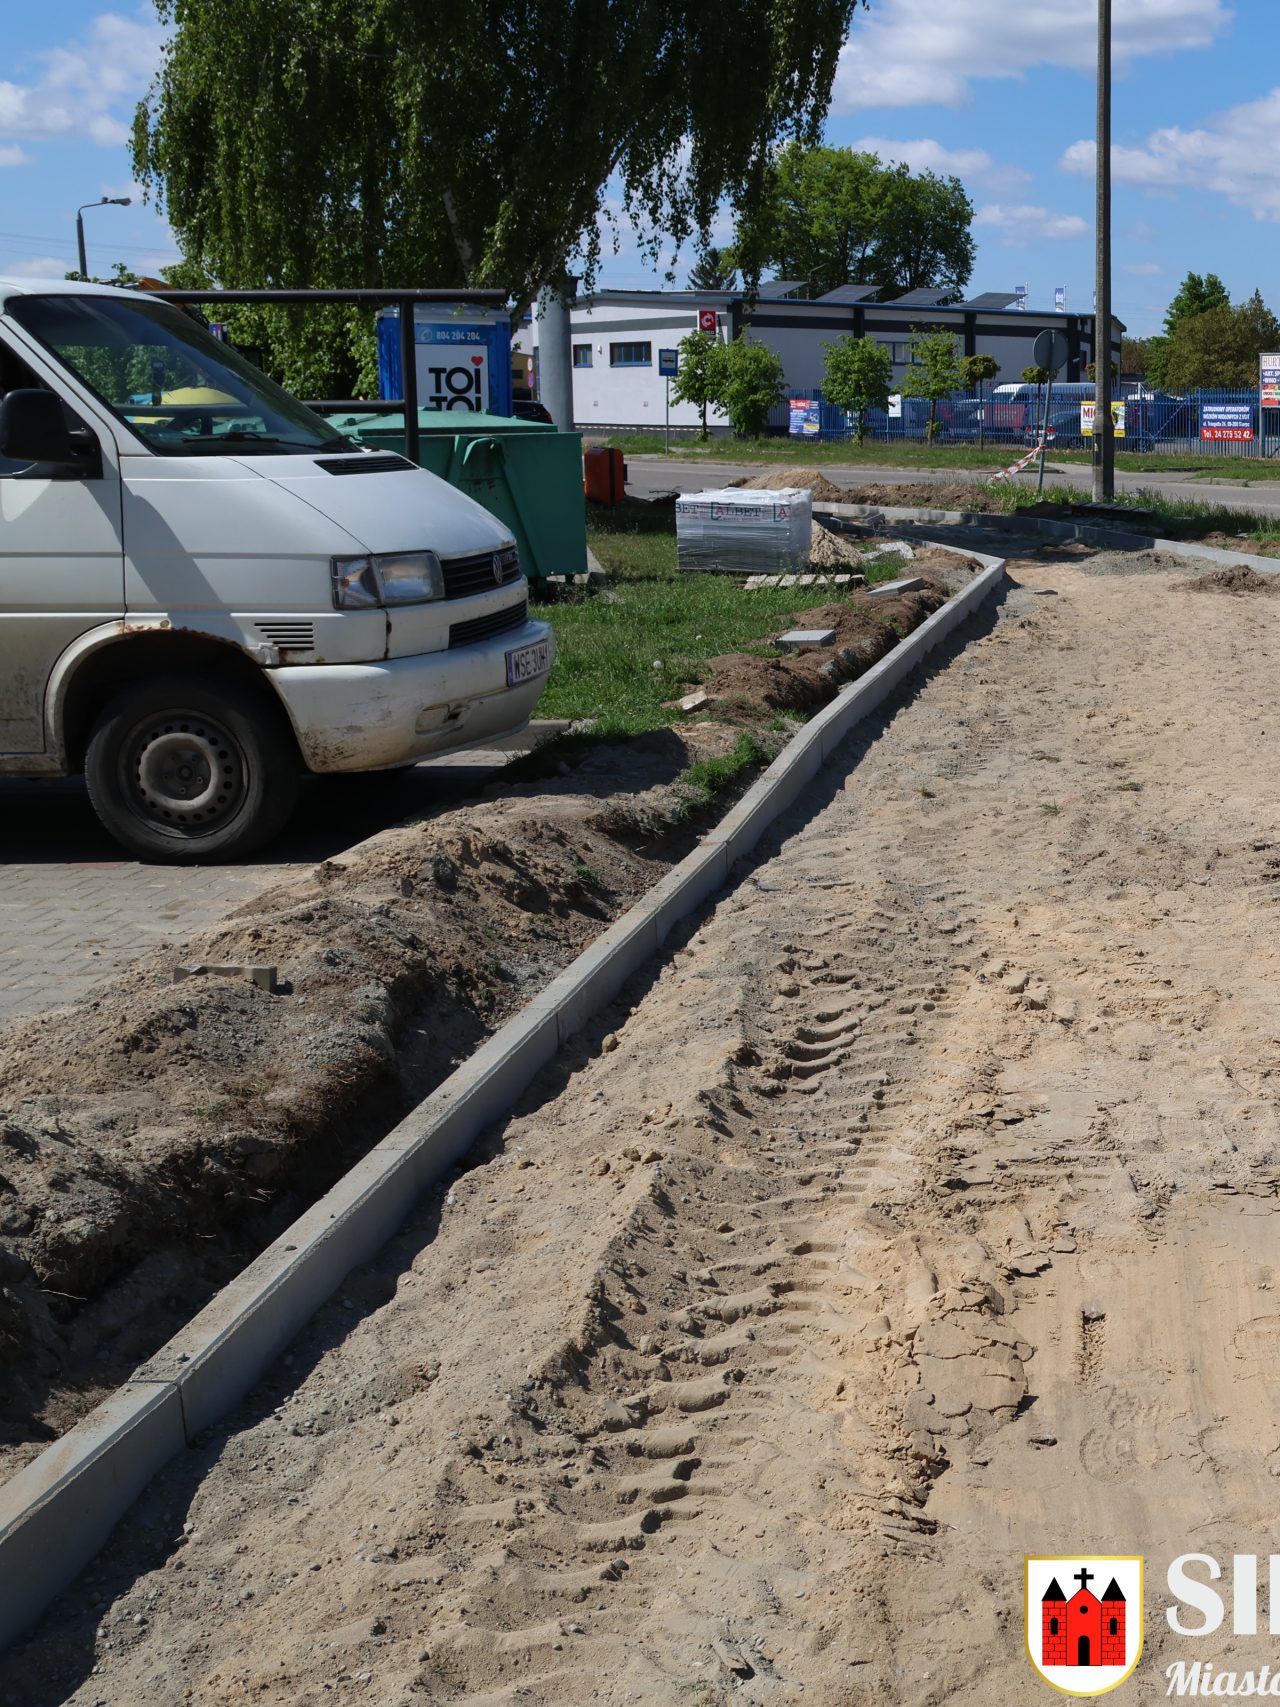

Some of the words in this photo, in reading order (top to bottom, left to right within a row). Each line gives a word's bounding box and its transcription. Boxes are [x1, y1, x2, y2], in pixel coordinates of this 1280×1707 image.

[428, 366, 482, 395] TOI
[1214, 430, 1222, 438] 24
[1222, 431, 1233, 439] 275
